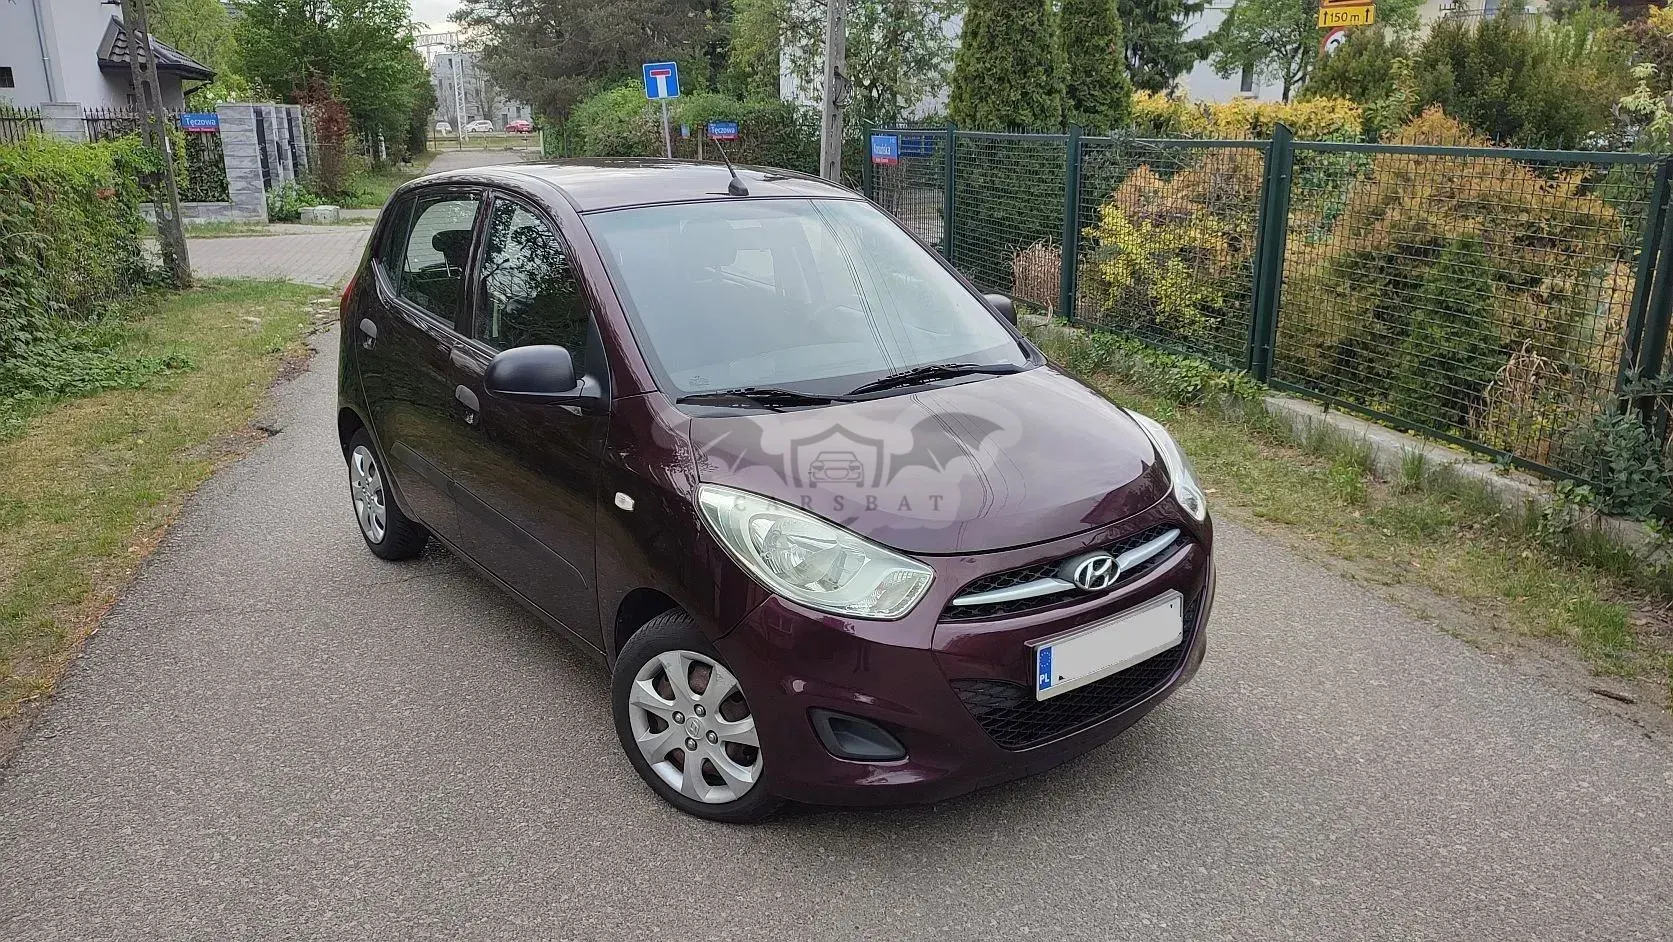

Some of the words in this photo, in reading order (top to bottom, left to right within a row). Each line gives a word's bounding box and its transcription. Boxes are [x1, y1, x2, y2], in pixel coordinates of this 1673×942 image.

[1330, 12, 1348, 23] 150
[1350, 14, 1360, 22] m
[186, 117, 216, 127] Tęczowa
[711, 126, 736, 135] Tęczowa
[1039, 672, 1050, 685] PL
